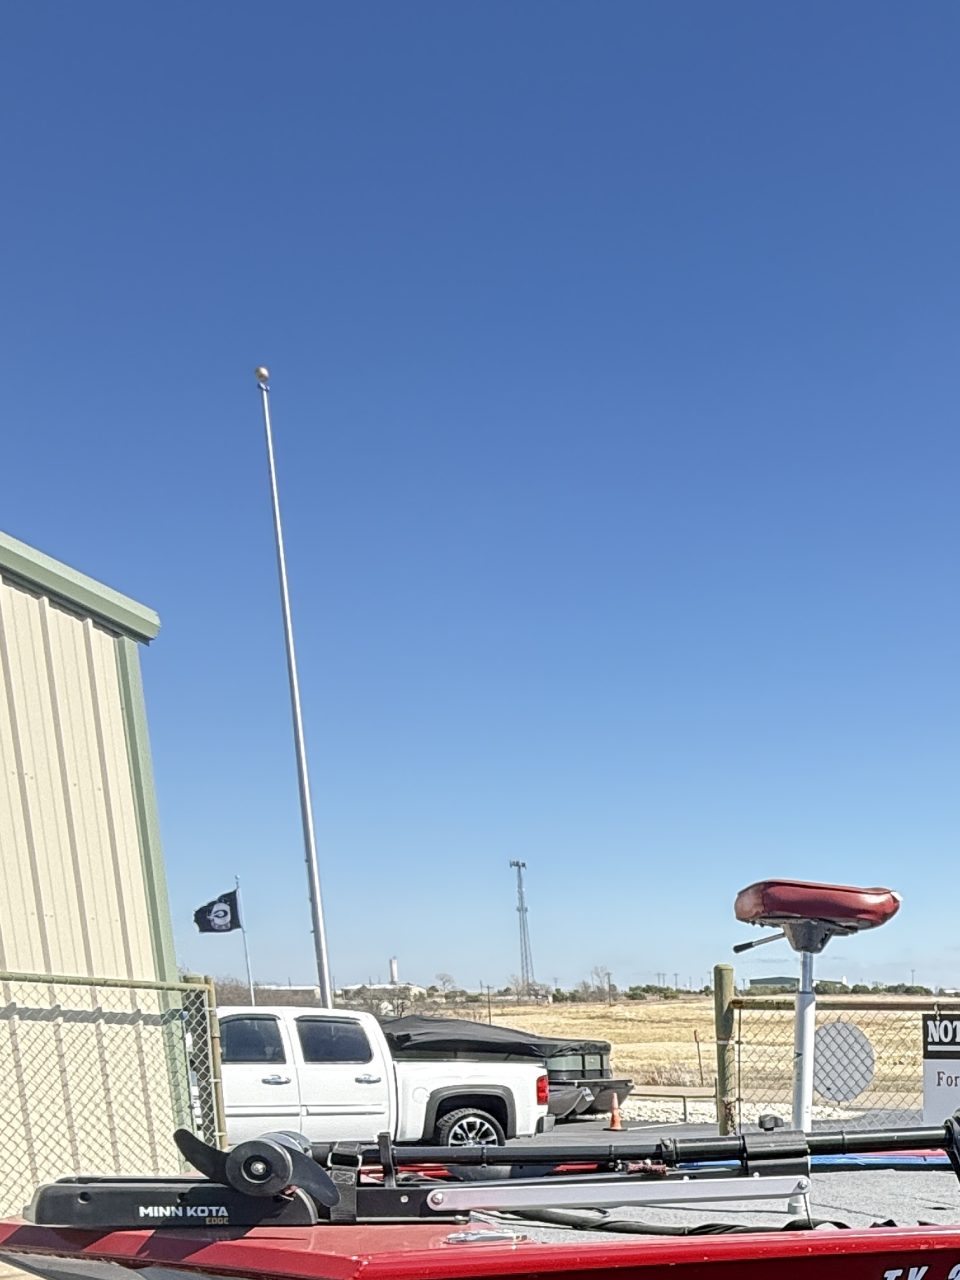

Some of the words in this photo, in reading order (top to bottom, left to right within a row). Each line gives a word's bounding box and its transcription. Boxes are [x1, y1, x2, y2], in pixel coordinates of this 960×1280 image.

[936, 1071, 960, 1087] For
[139, 1206, 183, 1217] MINN
[186, 1206, 229, 1217] KOTA
[205, 1217, 229, 1225] EDGE
